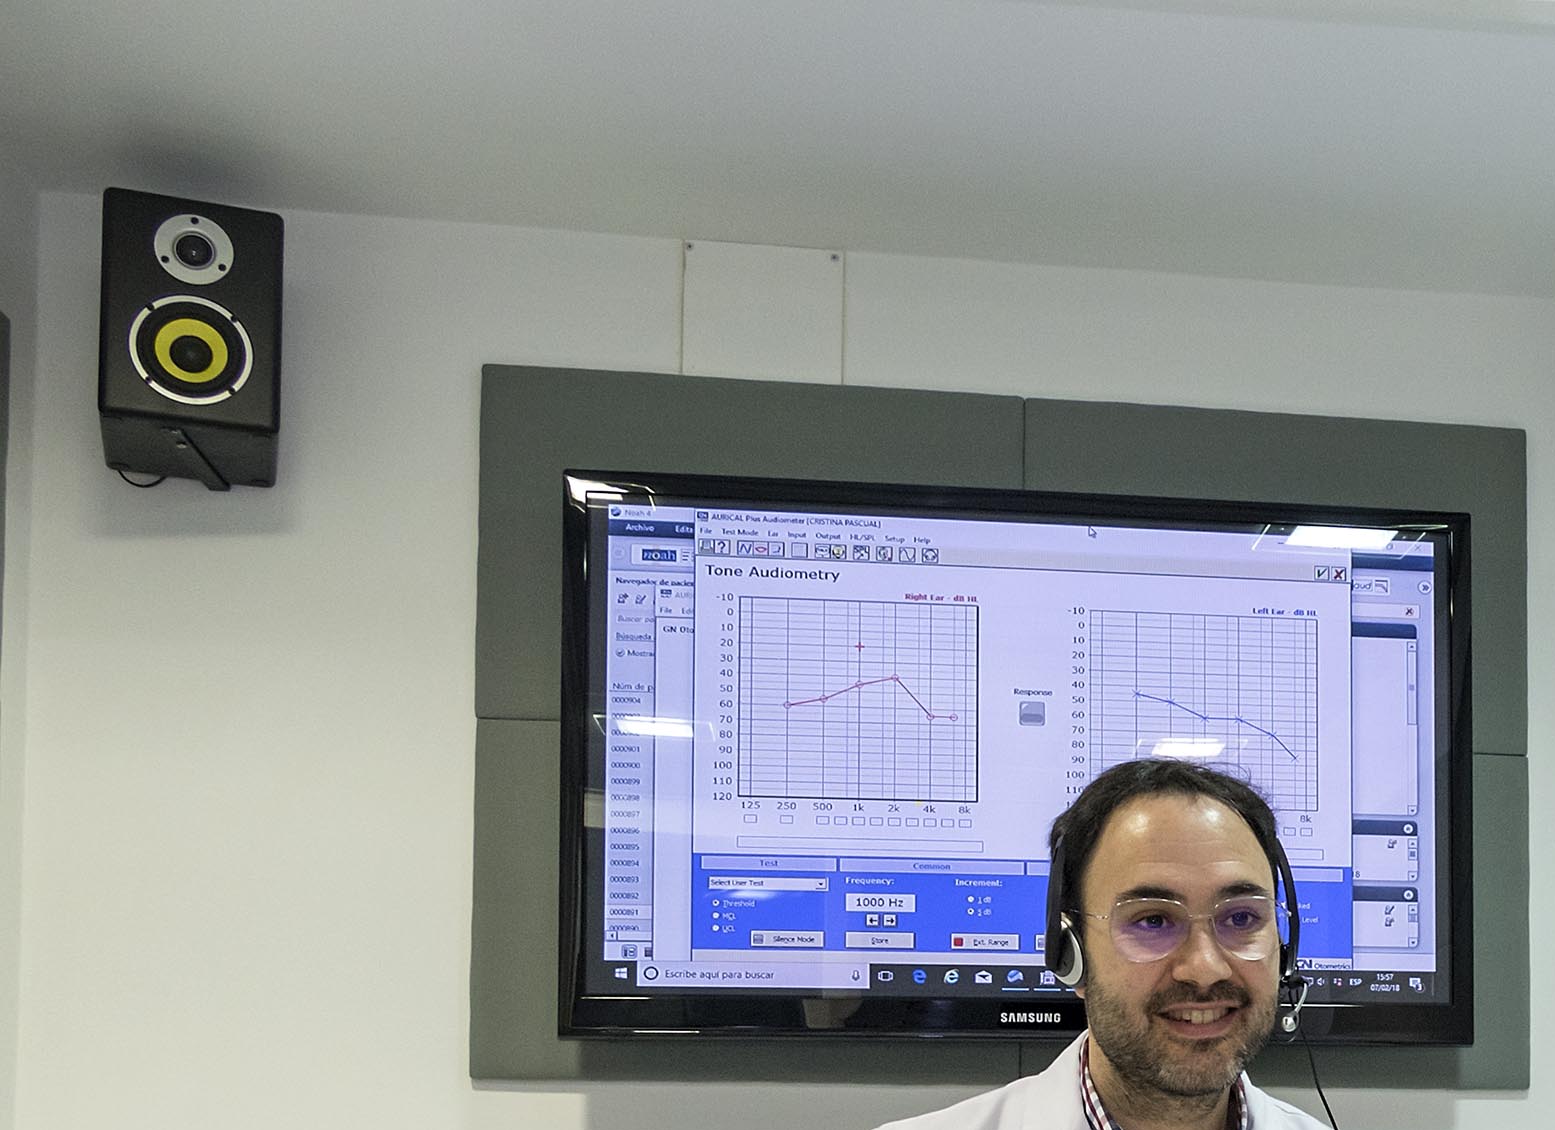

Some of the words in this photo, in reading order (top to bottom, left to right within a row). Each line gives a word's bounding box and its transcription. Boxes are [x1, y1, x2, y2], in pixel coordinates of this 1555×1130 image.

[625, 509, 646, 518] Noah
[711, 514, 743, 522] AURICAL
[745, 515, 761, 523] Plus
[762, 516, 805, 525] Audiometer
[625, 523, 655, 532] Archivo
[700, 527, 712, 535] File
[788, 532, 806, 540] Input
[815, 533, 841, 542] Output
[885, 535, 905, 544] Setup
[913, 537, 931, 545] Help
[643, 550, 676, 561] noah
[705, 564, 743, 577] Tone
[749, 567, 840, 582] Audiometry
[616, 577, 656, 587] Navegador
[716, 593, 734, 601] -10
[904, 593, 928, 602] Right
[1067, 607, 1085, 615] -10
[1252, 607, 1269, 615] Left
[663, 625, 677, 633] GN
[1078, 621, 1085, 629] 0
[616, 632, 652, 641] Búsqueda
[1072, 636, 1085, 644] 10
[719, 639, 733, 647] 20
[719, 654, 733, 662] 30
[1071, 651, 1085, 659] 20
[719, 669, 733, 677] 40
[1071, 666, 1085, 674] 30
[613, 682, 633, 690] Núm
[1014, 688, 1053, 697] Response
[719, 700, 733, 708] 60
[1071, 696, 1085, 704] 50
[1071, 711, 1085, 719] 60
[1071, 726, 1085, 734] 70
[719, 746, 732, 754] 90
[1071, 756, 1085, 764] 90
[713, 761, 732, 769] 100
[713, 777, 732, 785] 110
[713, 792, 732, 800] 120
[741, 801, 760, 809] 125
[777, 802, 796, 810] 250
[812, 803, 832, 811] 500
[853, 804, 864, 812] 1k
[888, 804, 900, 813] 2k
[923, 805, 936, 814] 4k
[958, 805, 971, 814] 8k
[1299, 815, 1312, 823] 8k
[845, 877, 895, 886] Frequency:
[955, 879, 1003, 887] Increment:
[723, 900, 756, 908] Threshold
[856, 898, 884, 907] 1000
[889, 899, 904, 907] Hz
[871, 937, 889, 945] Store
[988, 938, 1009, 947] Range
[1314, 962, 1351, 970] Otometrics
[665, 970, 696, 979] Escribe
[699, 970, 719, 981] aquí
[722, 972, 743, 981] para
[745, 970, 774, 979] buscar
[1000, 1012, 1061, 1023] SAMSUNG
